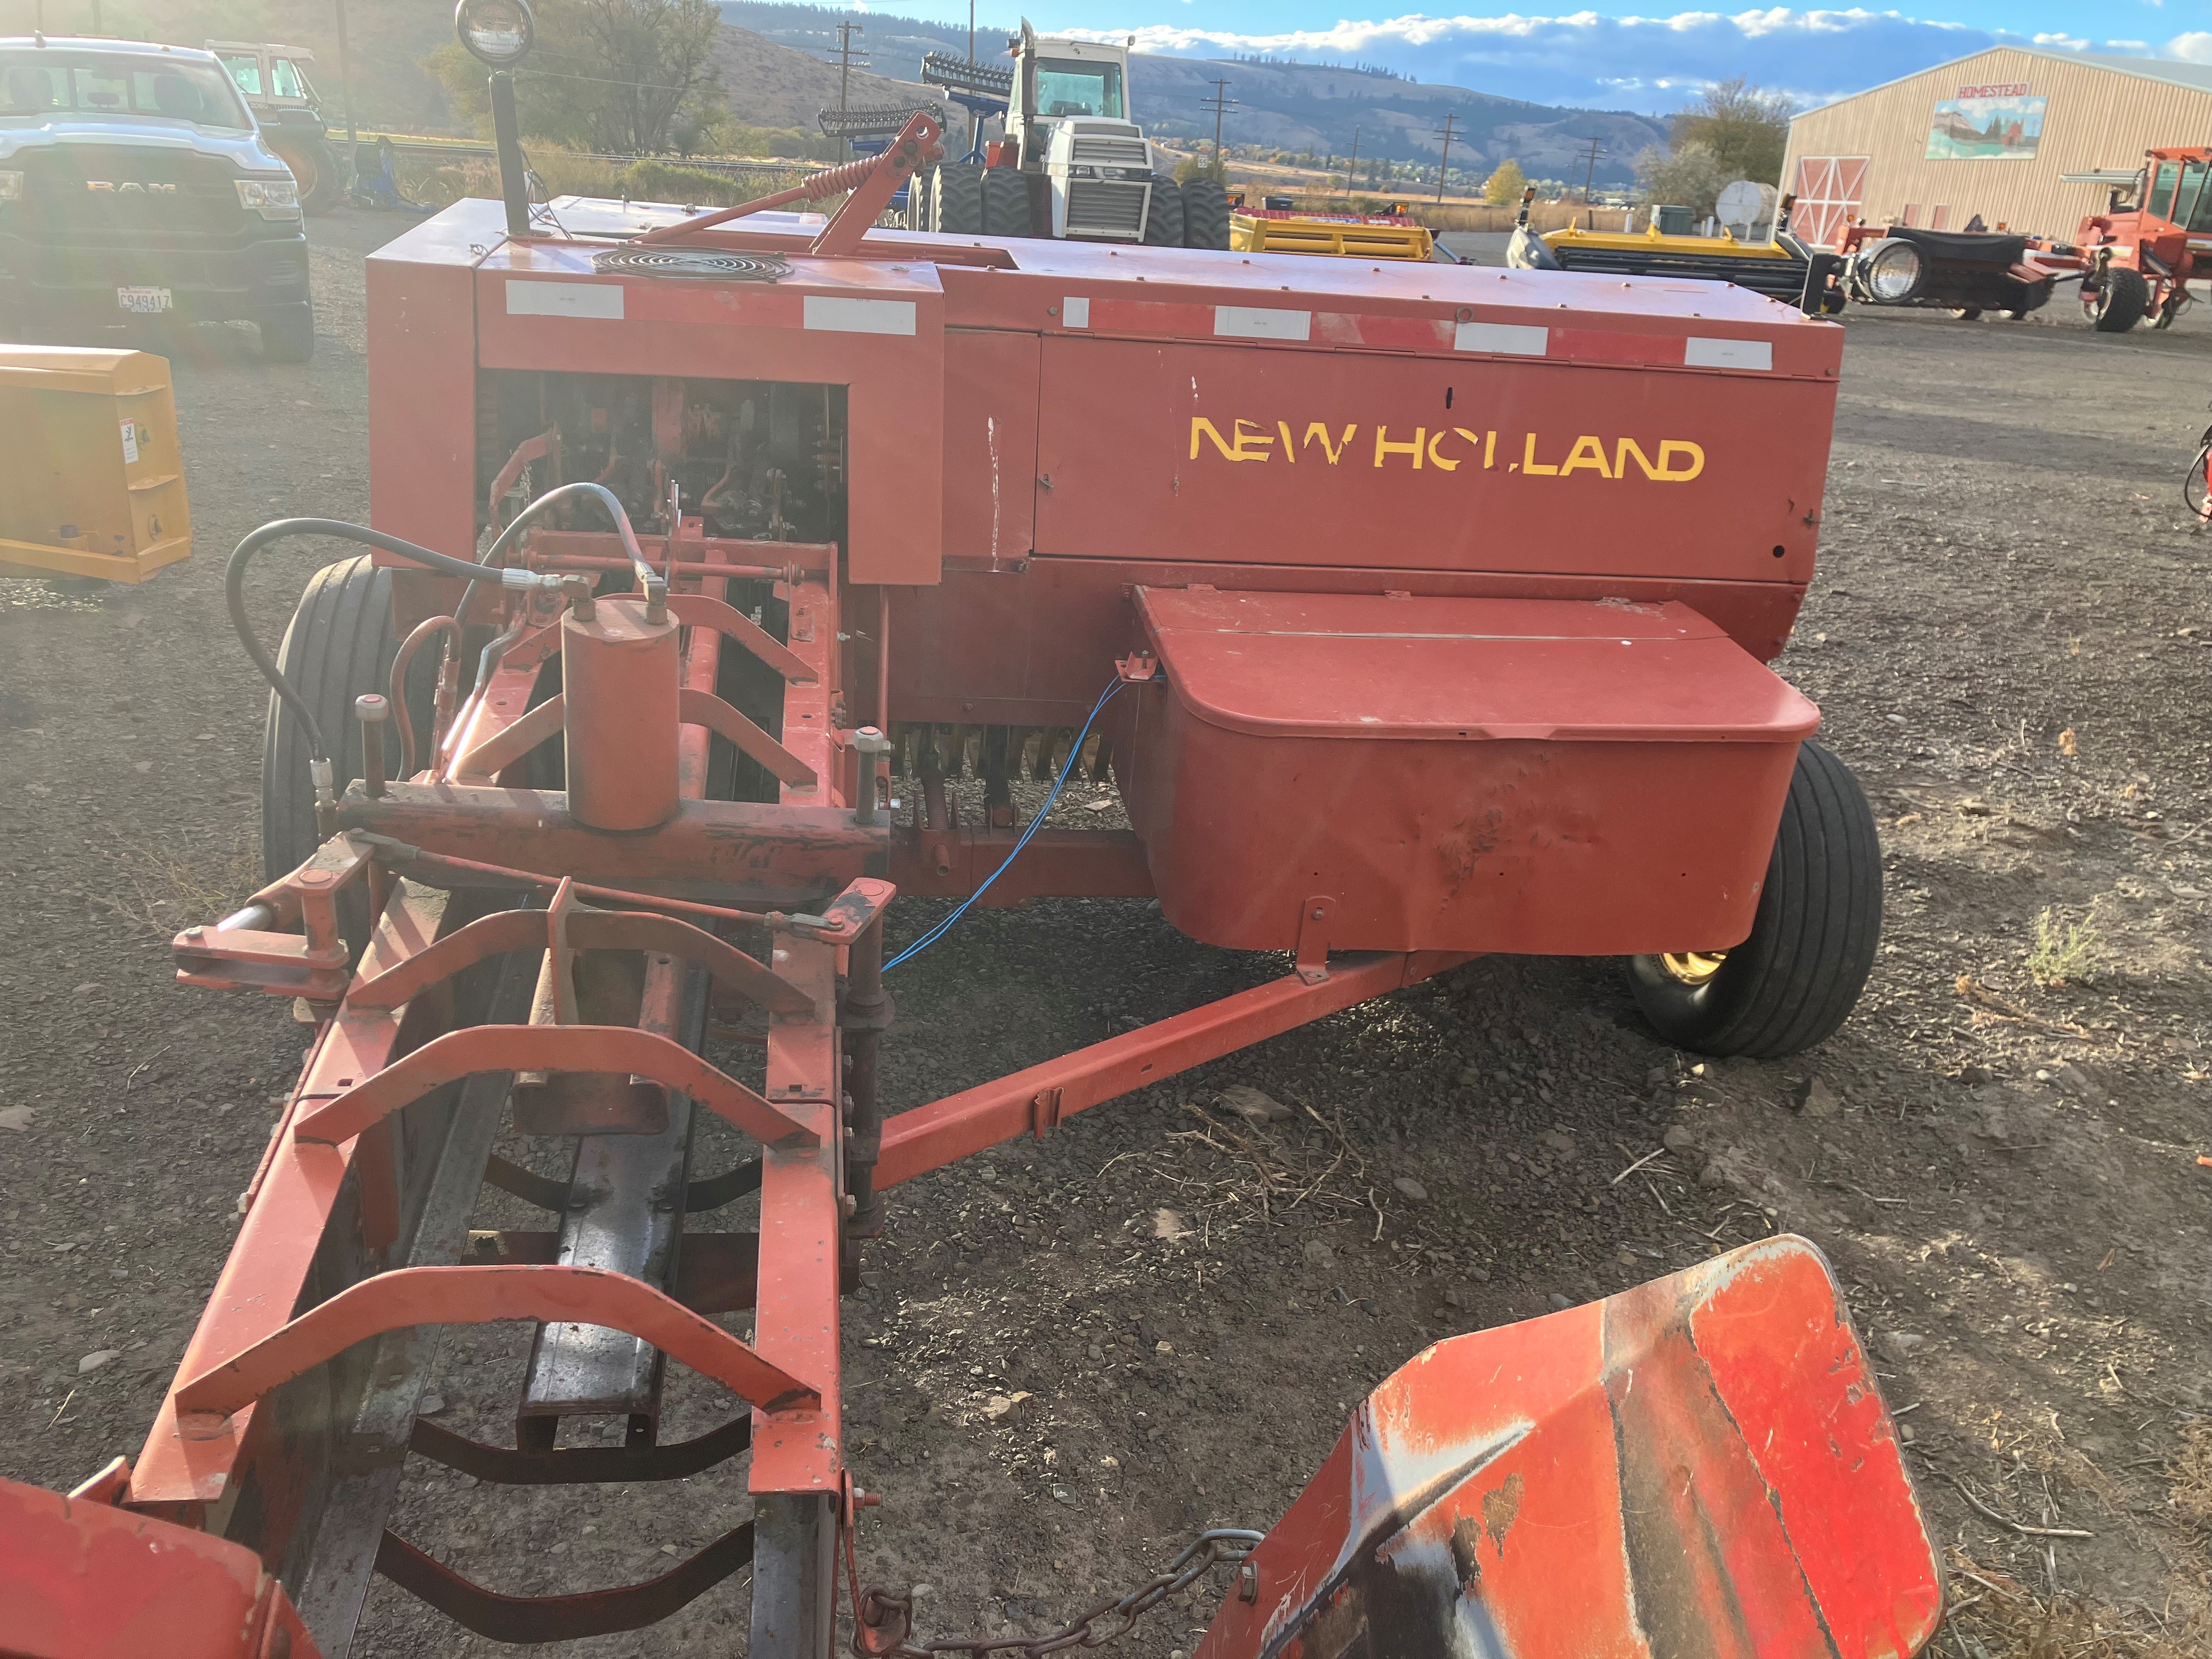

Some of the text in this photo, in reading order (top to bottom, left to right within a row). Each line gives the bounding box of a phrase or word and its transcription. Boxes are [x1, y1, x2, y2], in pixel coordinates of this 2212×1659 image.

[1958, 83, 2027, 98] HOMESTEAD
[1199, 159, 1207, 167] 55
[86, 180, 176, 193] RAM
[121, 295, 171, 308] C94941Z
[1190, 416, 1358, 465] NEW
